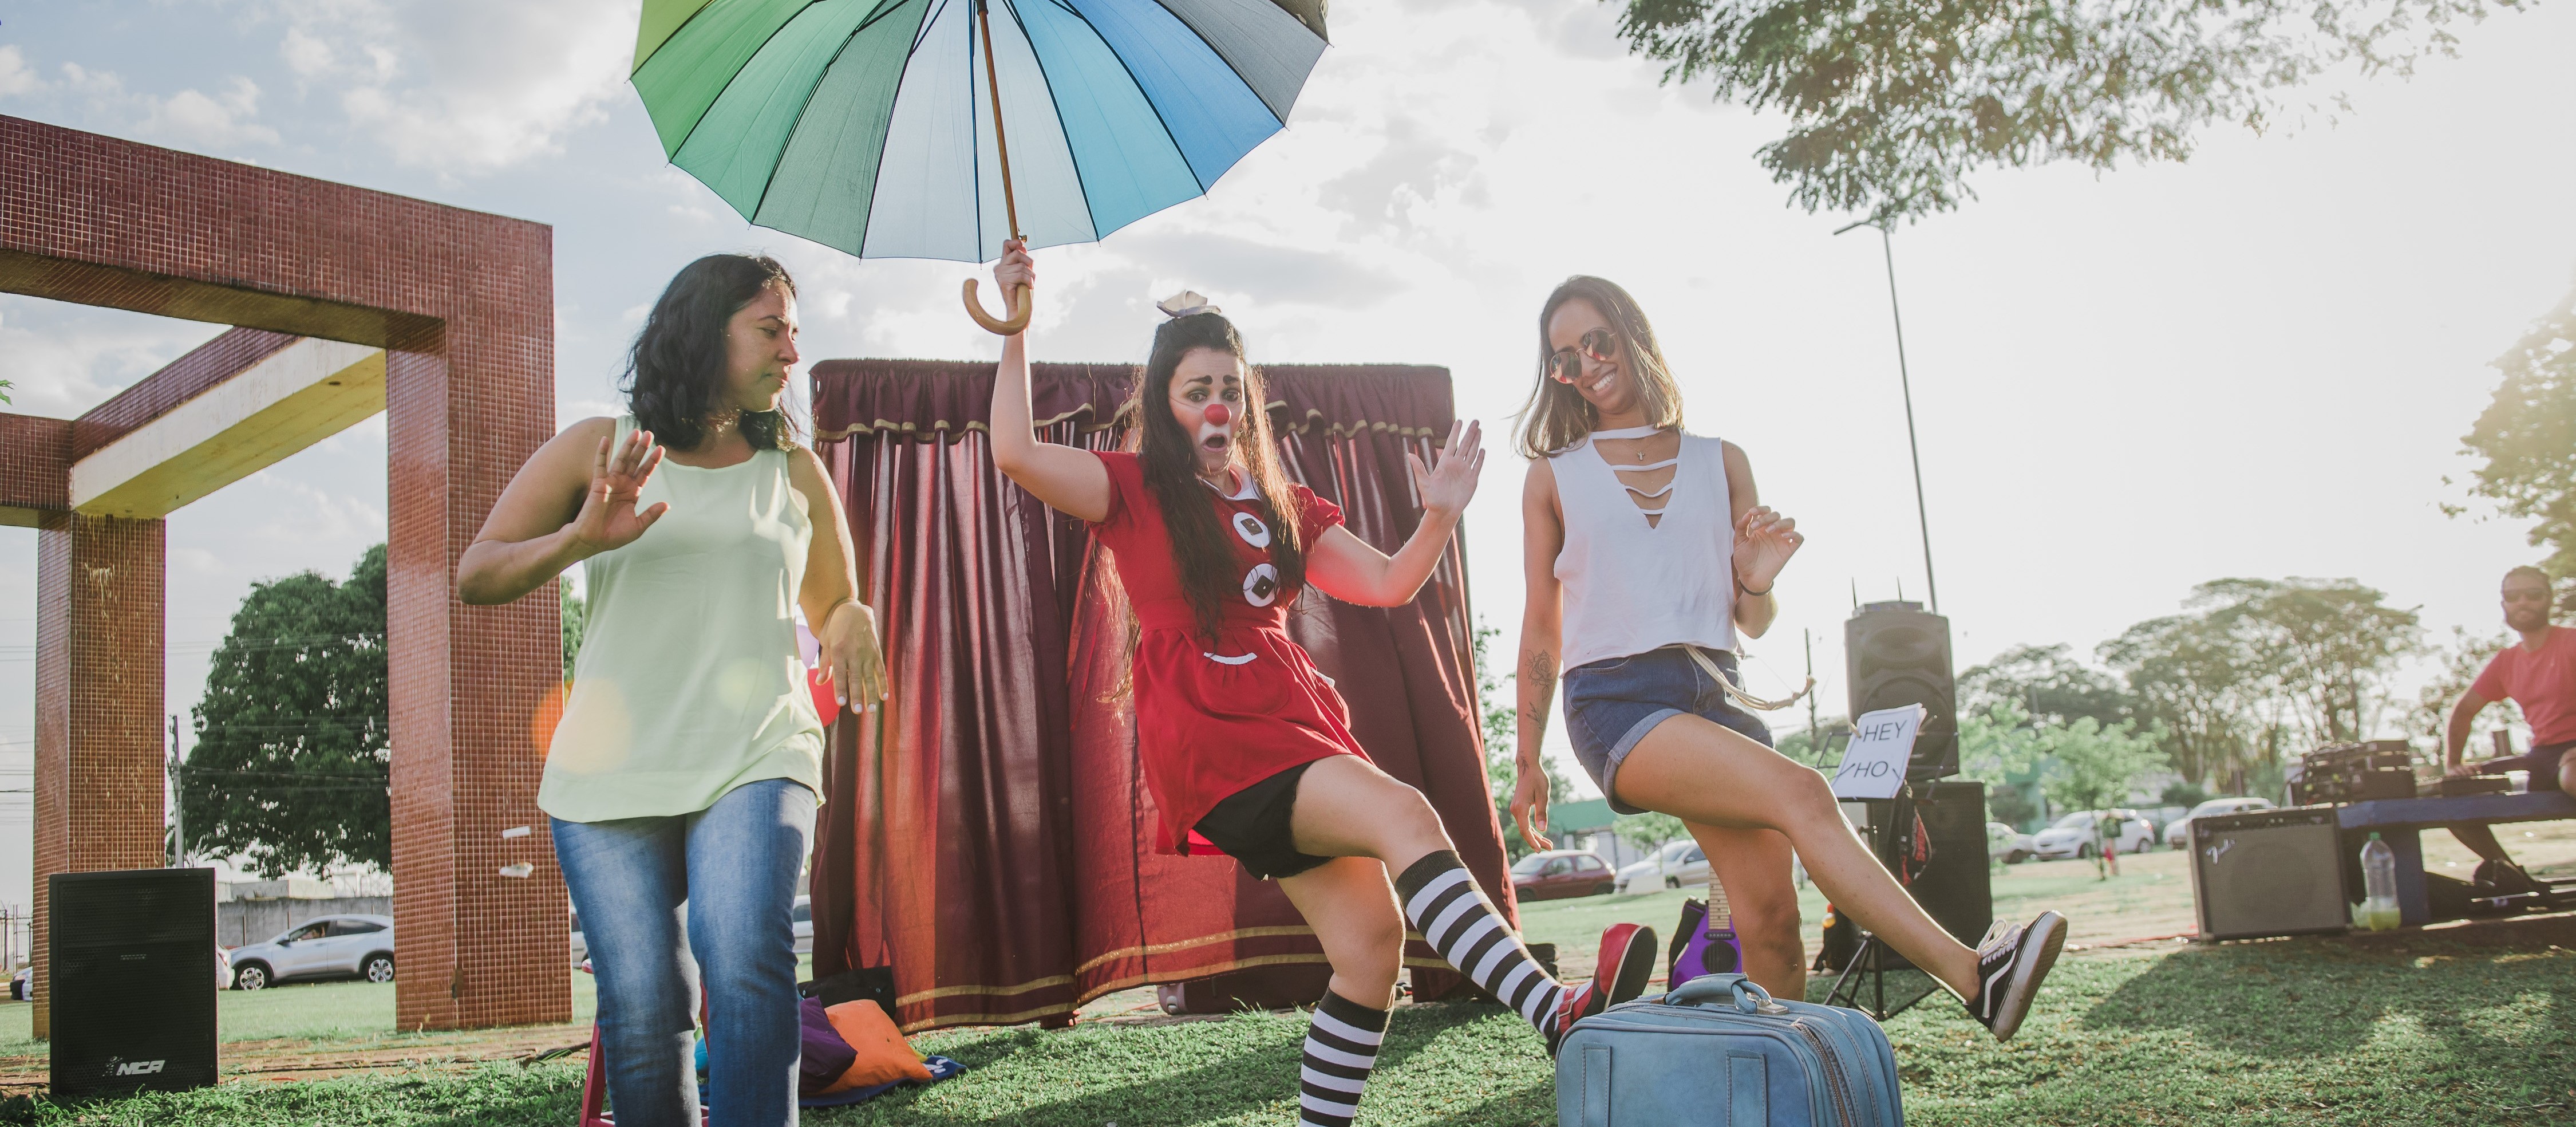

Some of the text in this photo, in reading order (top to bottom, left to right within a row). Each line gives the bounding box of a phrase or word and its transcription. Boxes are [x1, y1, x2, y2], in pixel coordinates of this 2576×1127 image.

[1862, 719, 1907, 742] HEY
[1854, 760, 1888, 778] HO
[116, 1060, 165, 1076] NCA
